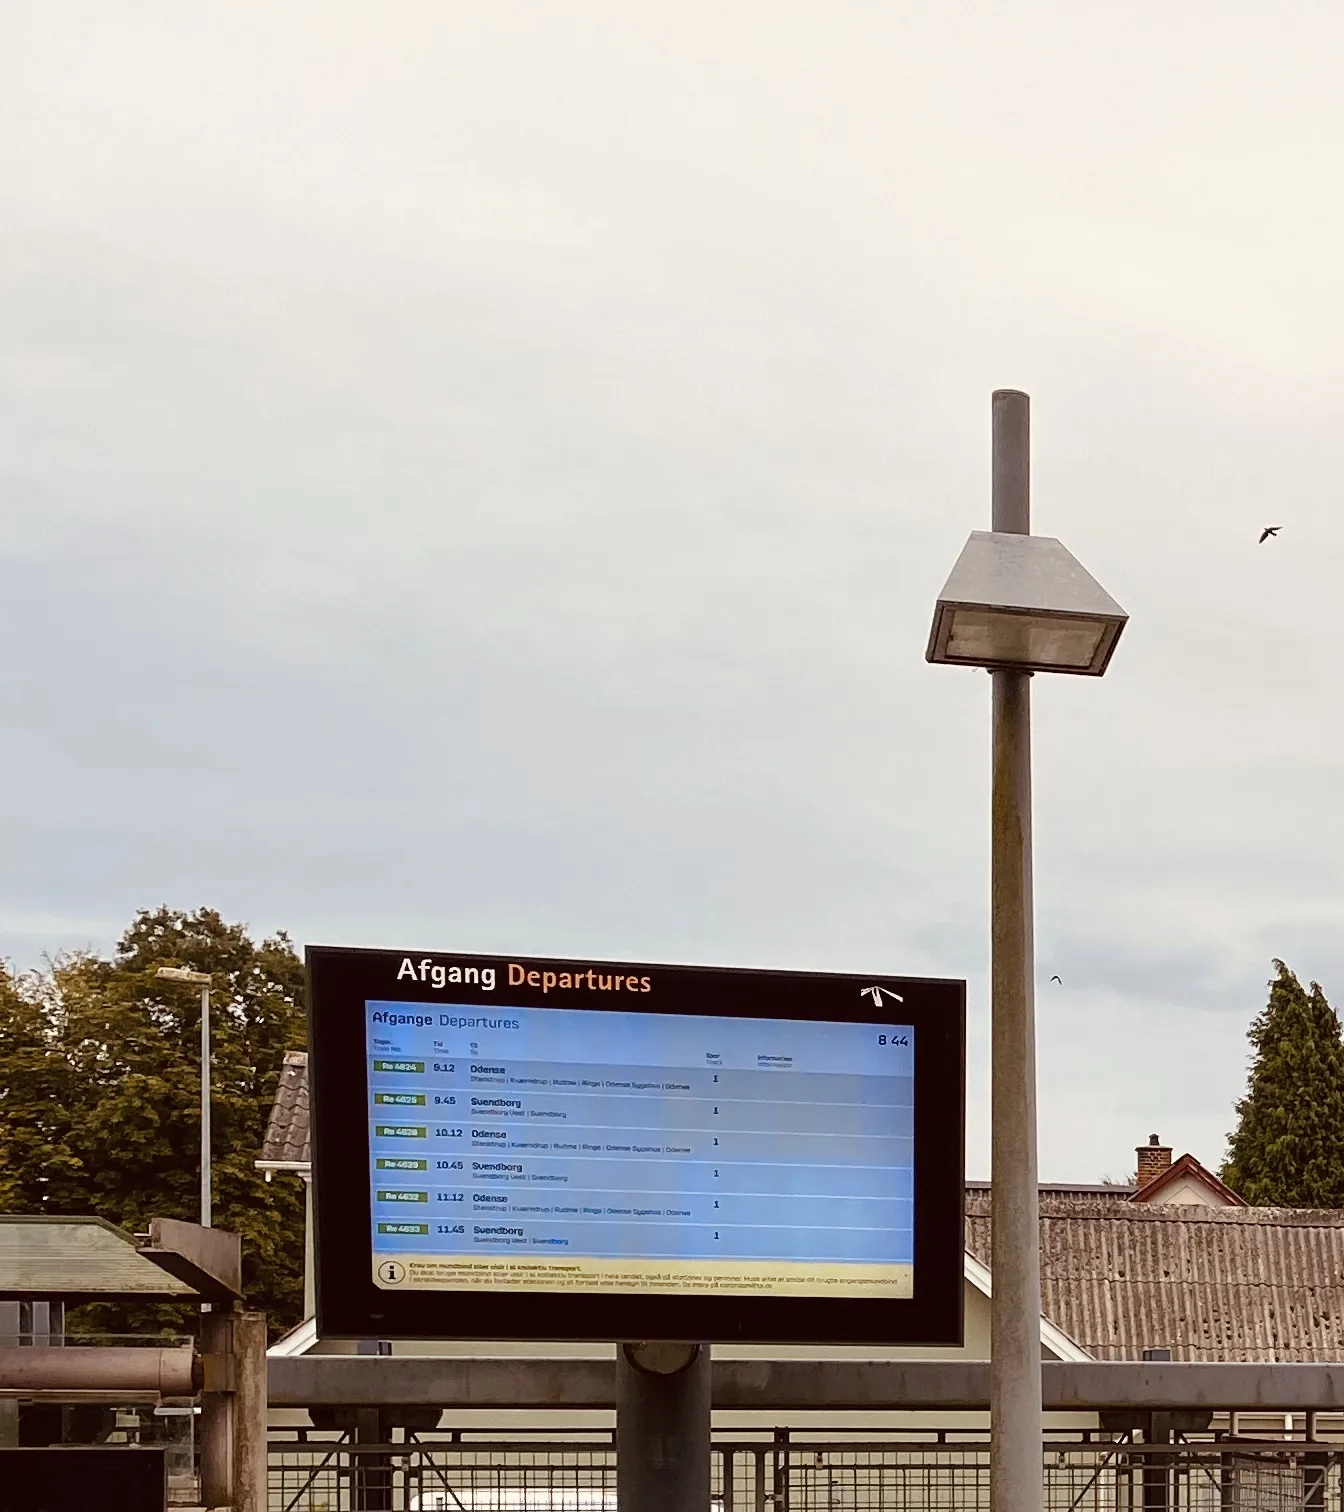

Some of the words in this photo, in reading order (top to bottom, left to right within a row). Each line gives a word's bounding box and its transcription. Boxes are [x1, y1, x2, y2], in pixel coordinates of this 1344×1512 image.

[397, 958, 496, 991] Afgang
[508, 963, 651, 993] Departures
[372, 1011, 433, 1027] Afgange
[439, 1014, 519, 1030] Departures
[433, 1064, 455, 1072] 9.12
[470, 1065, 505, 1074] Odense
[434, 1096, 456, 1105] 9.45
[471, 1098, 521, 1108] Svendborg
[436, 1129, 463, 1137] 10.12
[472, 1130, 507, 1138] Odense
[436, 1161, 463, 1170] 10.45
[472, 1162, 522, 1172] Svendborg
[437, 1194, 464, 1202] 11.12
[473, 1194, 508, 1202] Odense
[438, 1226, 464, 1234] 11.45
[474, 1226, 523, 1236] Svendborg
